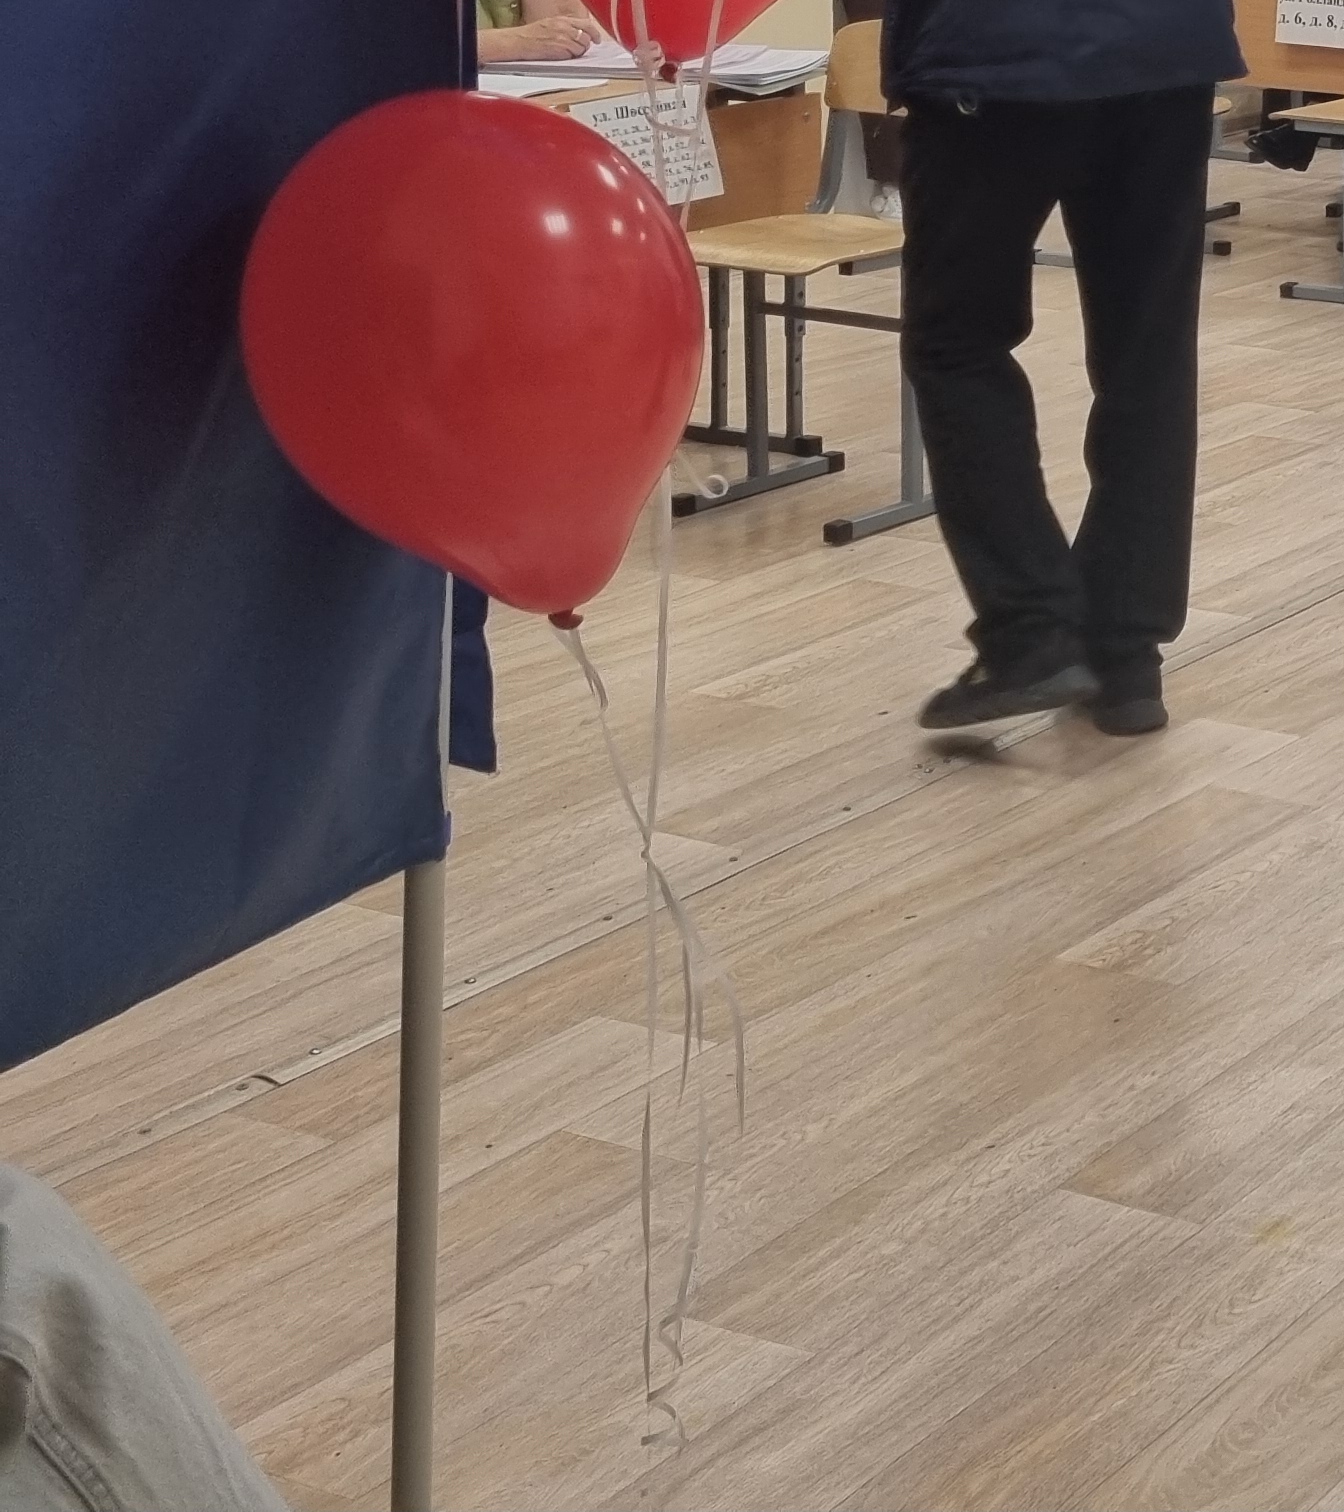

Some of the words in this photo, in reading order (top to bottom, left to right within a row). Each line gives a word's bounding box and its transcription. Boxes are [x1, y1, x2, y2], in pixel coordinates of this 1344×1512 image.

[1278, 13, 1290, 24] д.
[1295, 12, 1306, 26] 6,
[1309, 16, 1322, 27] д.
[1326, 15, 1338, 30] 8,
